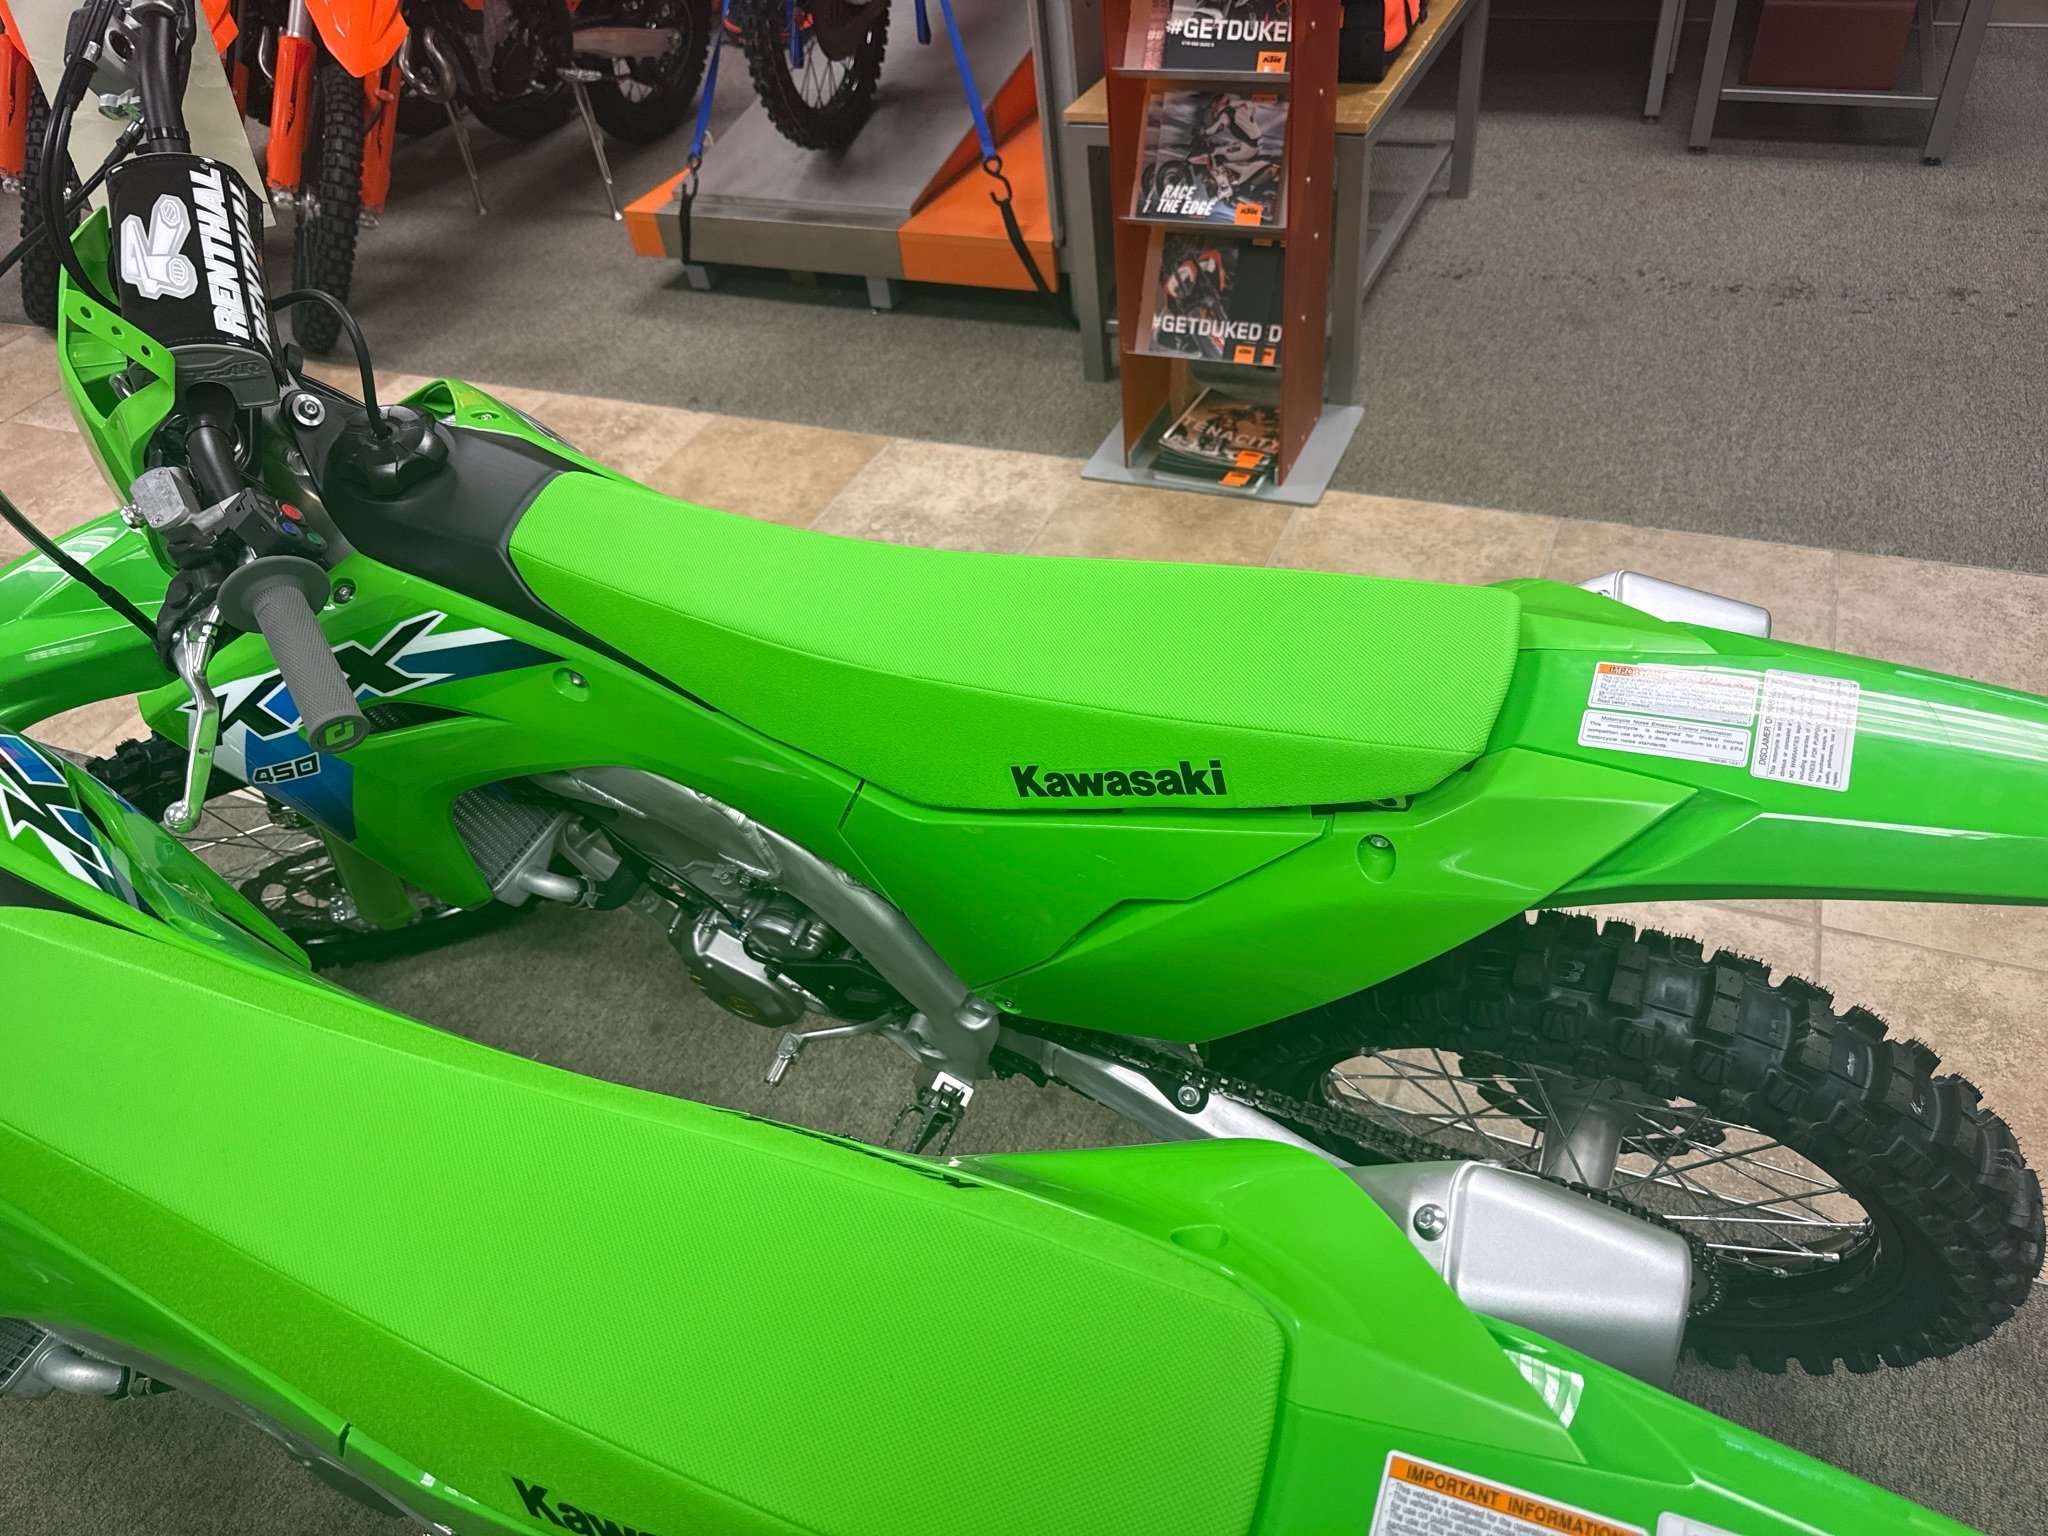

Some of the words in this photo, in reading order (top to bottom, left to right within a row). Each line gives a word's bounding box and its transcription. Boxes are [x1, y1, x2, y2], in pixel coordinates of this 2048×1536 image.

[1161, 184, 1197, 200] RACE
[1156, 199, 1181, 214] THE
[1181, 200, 1216, 216] EDGE
[189, 168, 250, 341] RENTHAL
[1181, 415, 1280, 455] TENACITY
[1587, 727, 1619, 735] competition
[1601, 715, 1631, 724] Motorcycle
[1651, 721, 1677, 729] Emission
[1700, 728, 1733, 737] Information
[1607, 723, 1639, 731] motorcycle
[1586, 733, 1618, 742] motorcycle
[1758, 726, 1771, 766] DISCLAIMER
[1772, 739, 1780, 763] motorcycle
[1790, 736, 1800, 768] WARRANTIES
[253, 752, 321, 785] 450
[1009, 759, 1228, 798] Kawasaki
[1789, 770, 1795, 779] NO
[1799, 760, 1808, 780] including
[1808, 760, 1817, 782] FITNESS
[1406, 1464, 1499, 1505] IMPORTANT
[1413, 1491, 1438, 1503] vehicle
